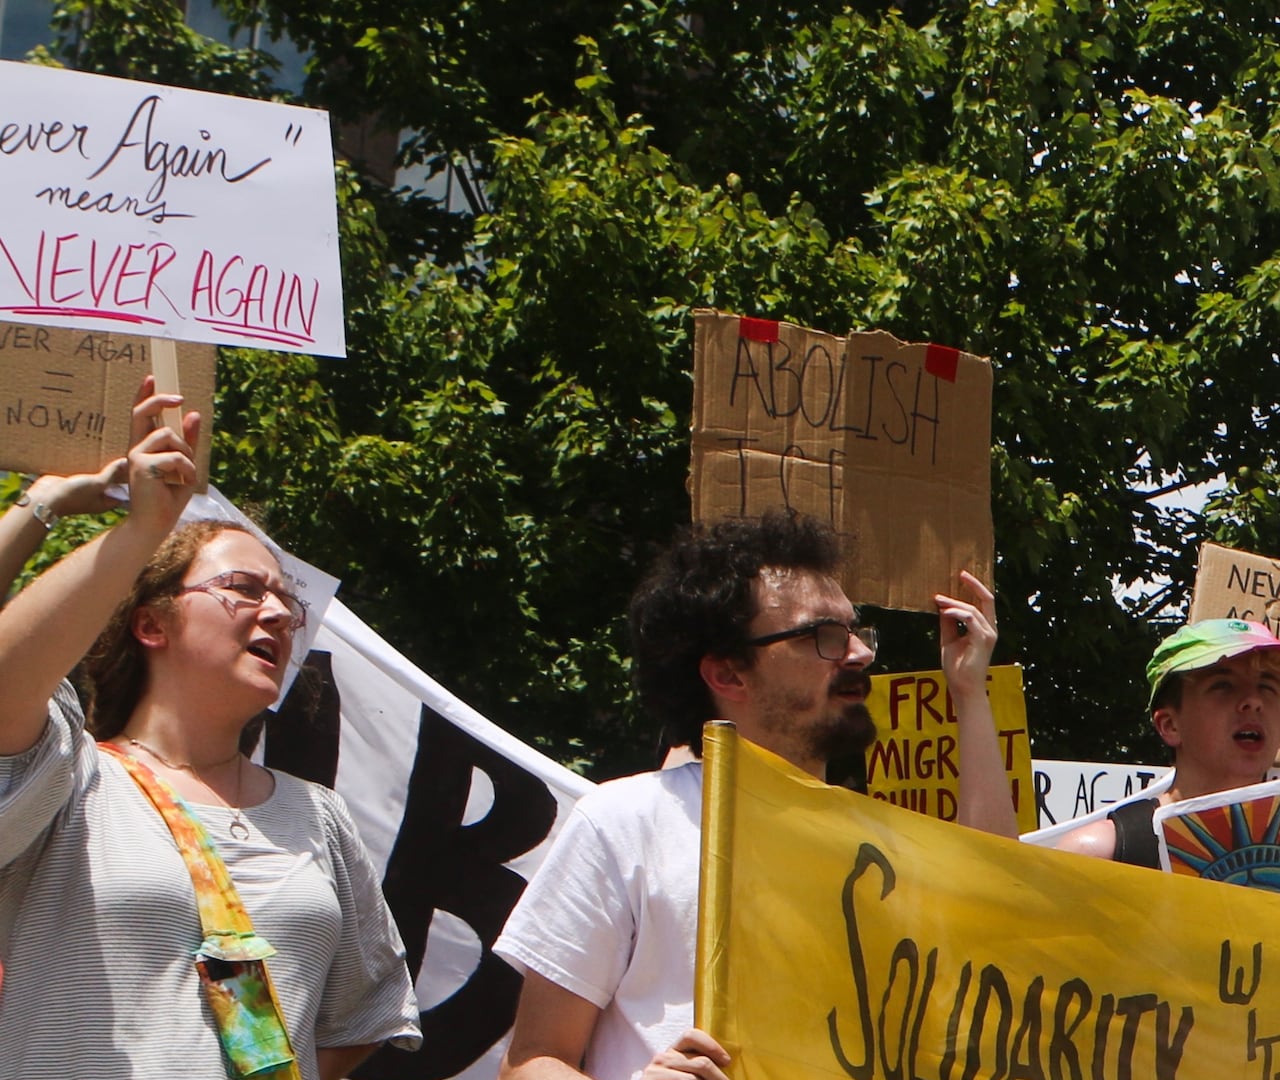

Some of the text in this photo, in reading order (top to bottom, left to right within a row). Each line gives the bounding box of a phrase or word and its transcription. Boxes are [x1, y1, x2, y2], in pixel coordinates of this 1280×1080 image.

[36, 183, 197, 224] means
[0, 230, 321, 336] NEVER AGAIN
[74, 334, 148, 364] AGAI
[6, 399, 107, 441] NOW!!!
[729, 336, 943, 467] ABOLISH
[867, 728, 1026, 786] MIGRT
